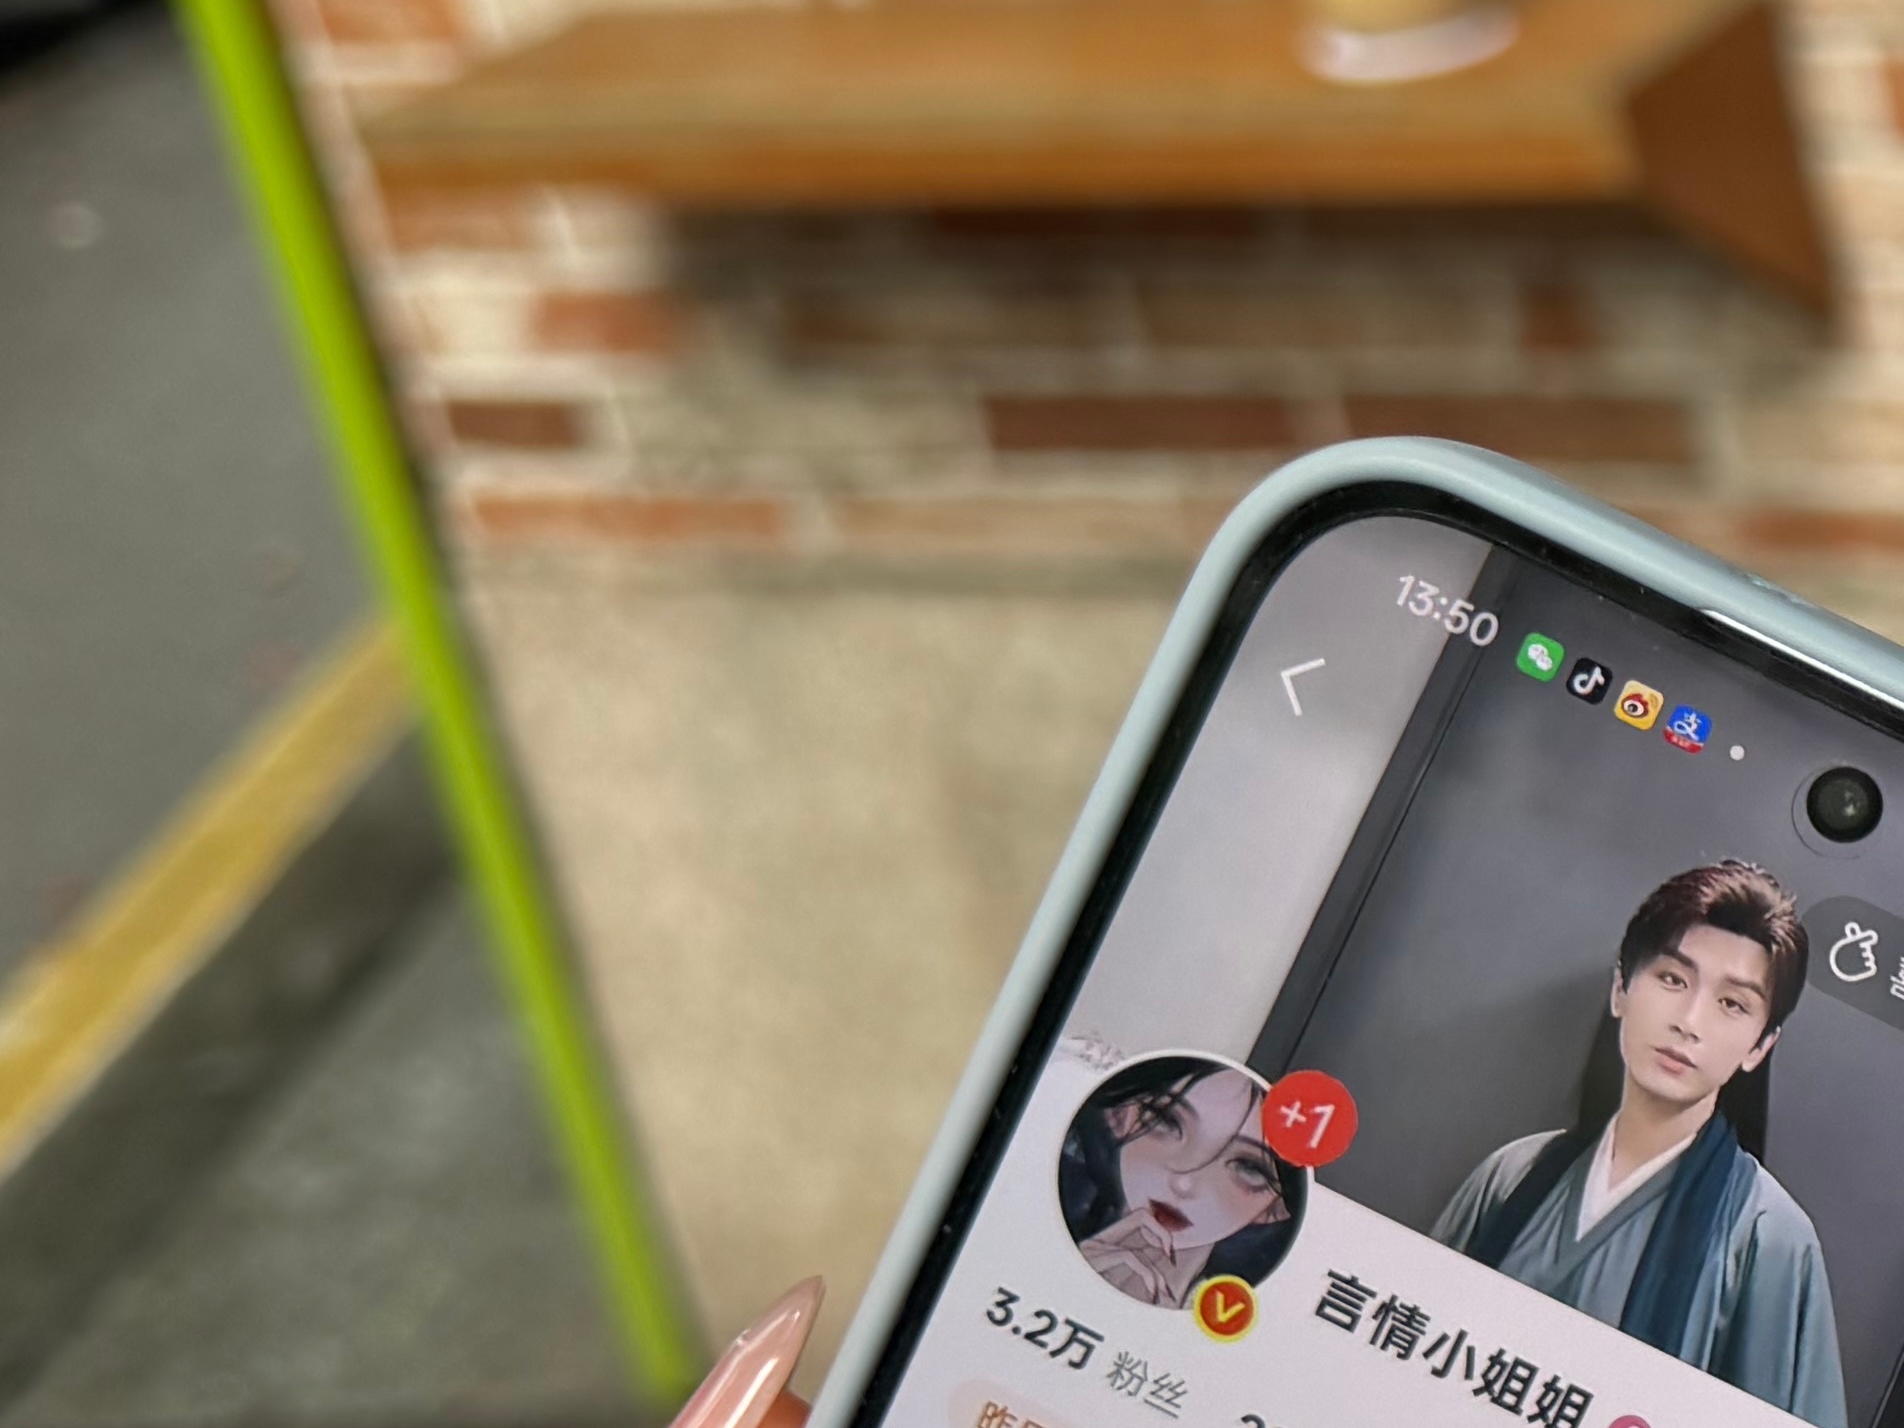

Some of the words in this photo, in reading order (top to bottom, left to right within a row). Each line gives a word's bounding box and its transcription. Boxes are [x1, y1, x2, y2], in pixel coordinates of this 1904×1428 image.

[1397, 575, 1499, 646] 13:50
[1278, 1095, 1337, 1152] +1
[985, 1285, 1105, 1371] 3.2万
[1105, 1350, 1191, 1419] 粉丝
